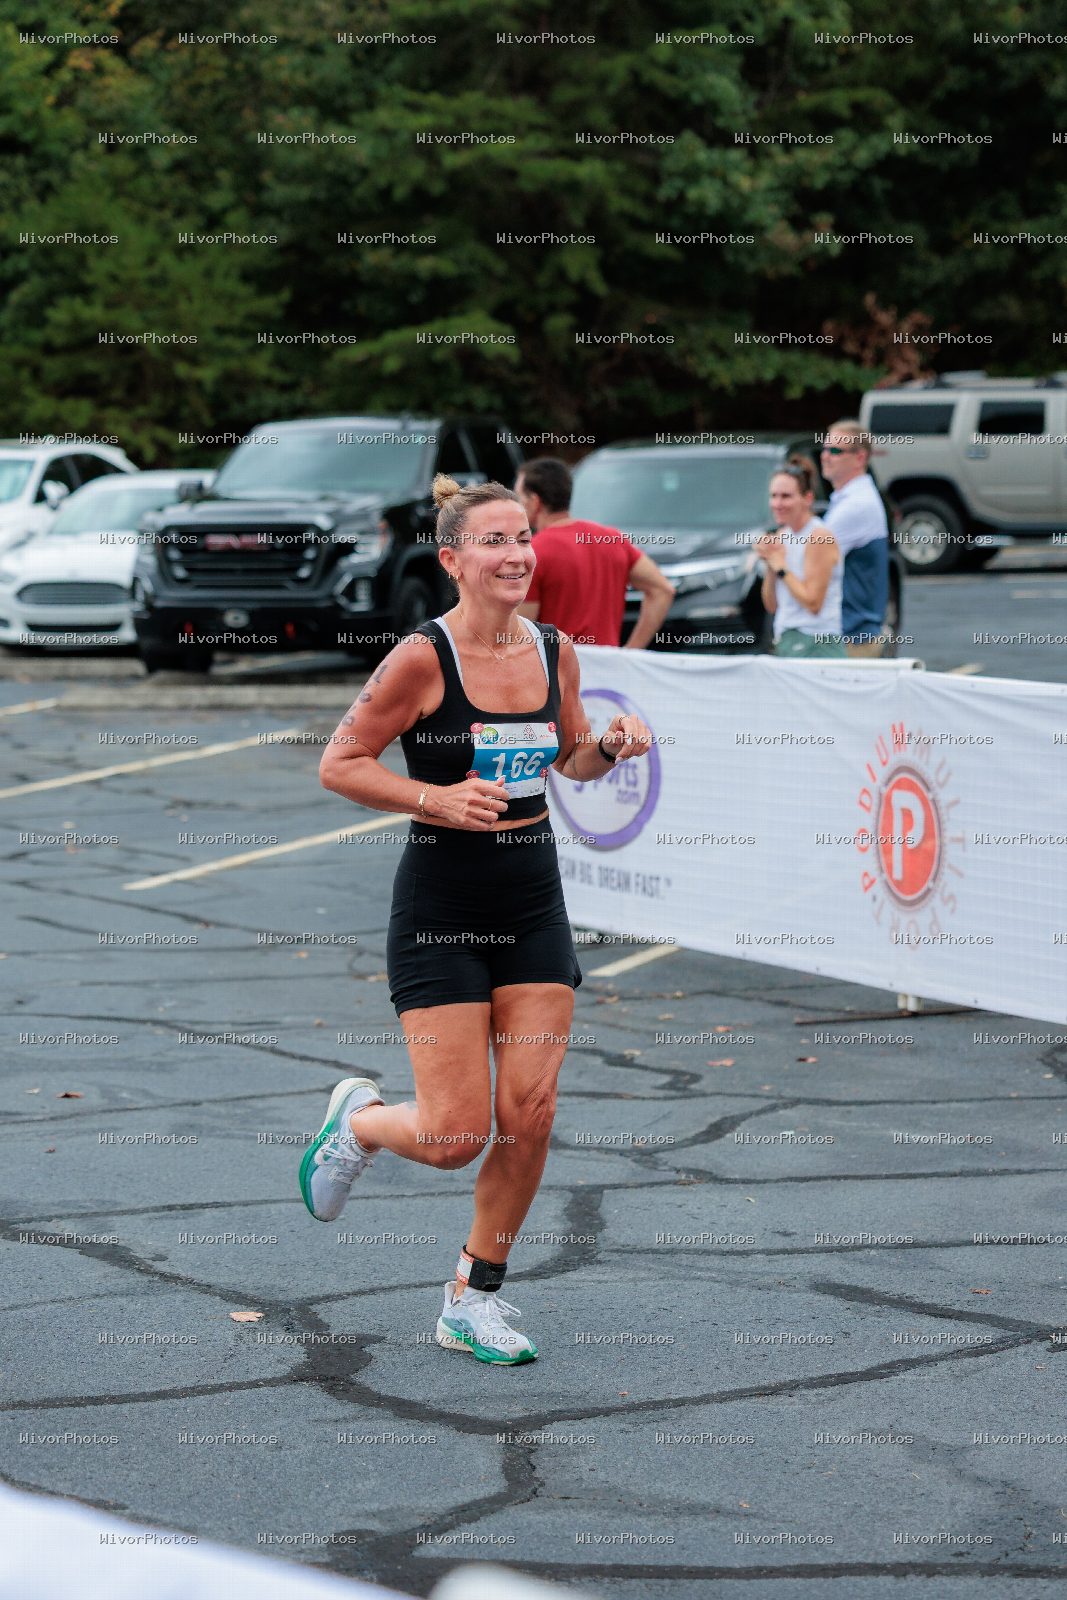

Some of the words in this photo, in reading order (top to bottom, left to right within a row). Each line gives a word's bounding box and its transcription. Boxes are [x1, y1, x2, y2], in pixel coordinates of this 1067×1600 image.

[492, 751, 545, 779] 166
[857, 721, 907, 893] PODIUM
[891, 788, 925, 881] P
